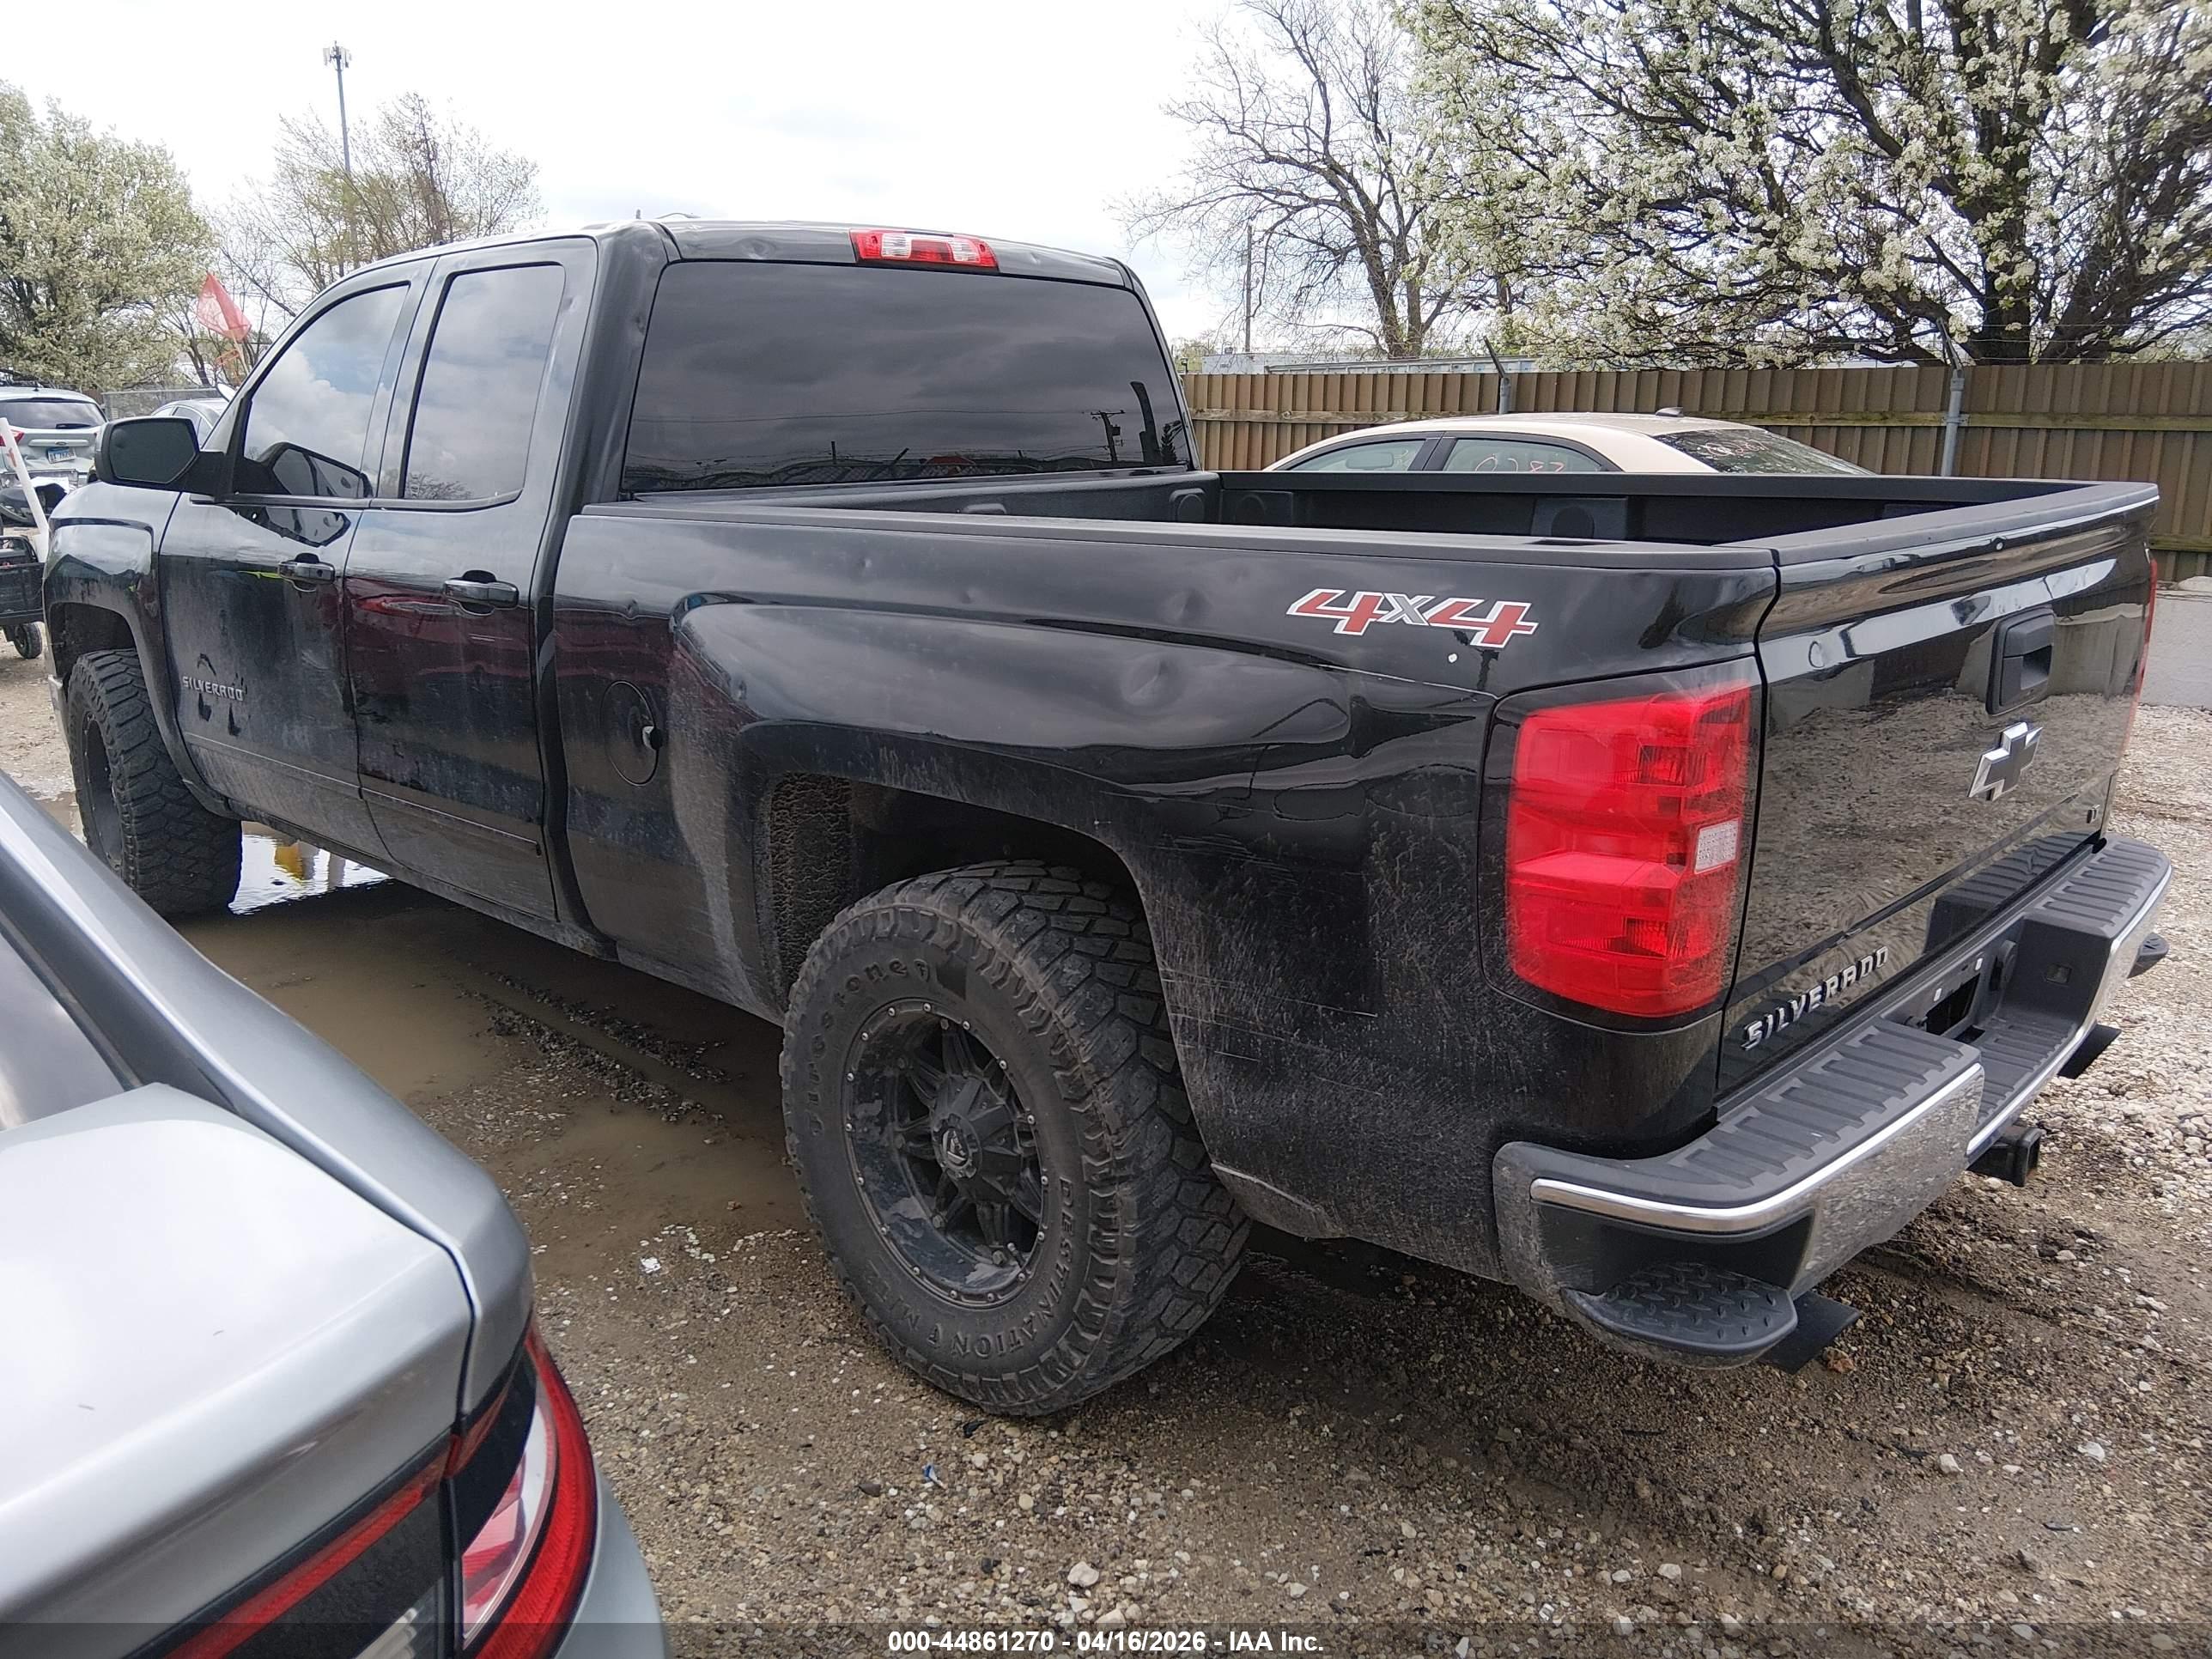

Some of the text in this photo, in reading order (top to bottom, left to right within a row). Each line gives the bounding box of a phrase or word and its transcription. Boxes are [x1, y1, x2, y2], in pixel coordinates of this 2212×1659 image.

[182, 676, 243, 702] SILVERADO
[1741, 945, 1888, 1051] SILVERADO
[951, 1176, 1076, 1358] DESTINATION
